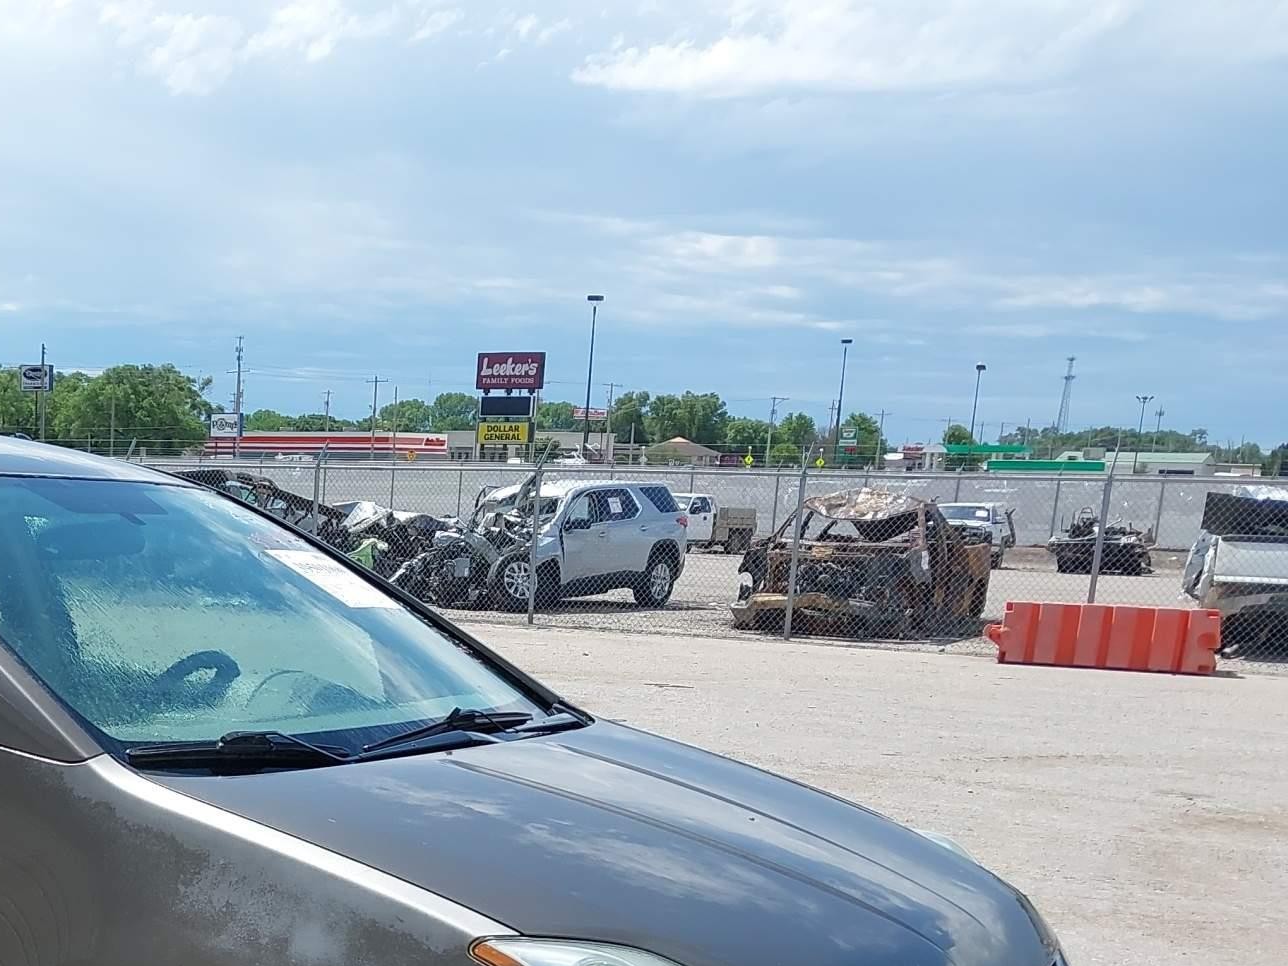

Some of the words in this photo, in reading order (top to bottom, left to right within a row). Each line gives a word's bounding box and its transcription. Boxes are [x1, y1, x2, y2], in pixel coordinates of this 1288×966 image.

[480, 357, 539, 376] Leeker's
[487, 424, 520, 432] DOLLAR
[484, 433, 522, 441] GENERAL
